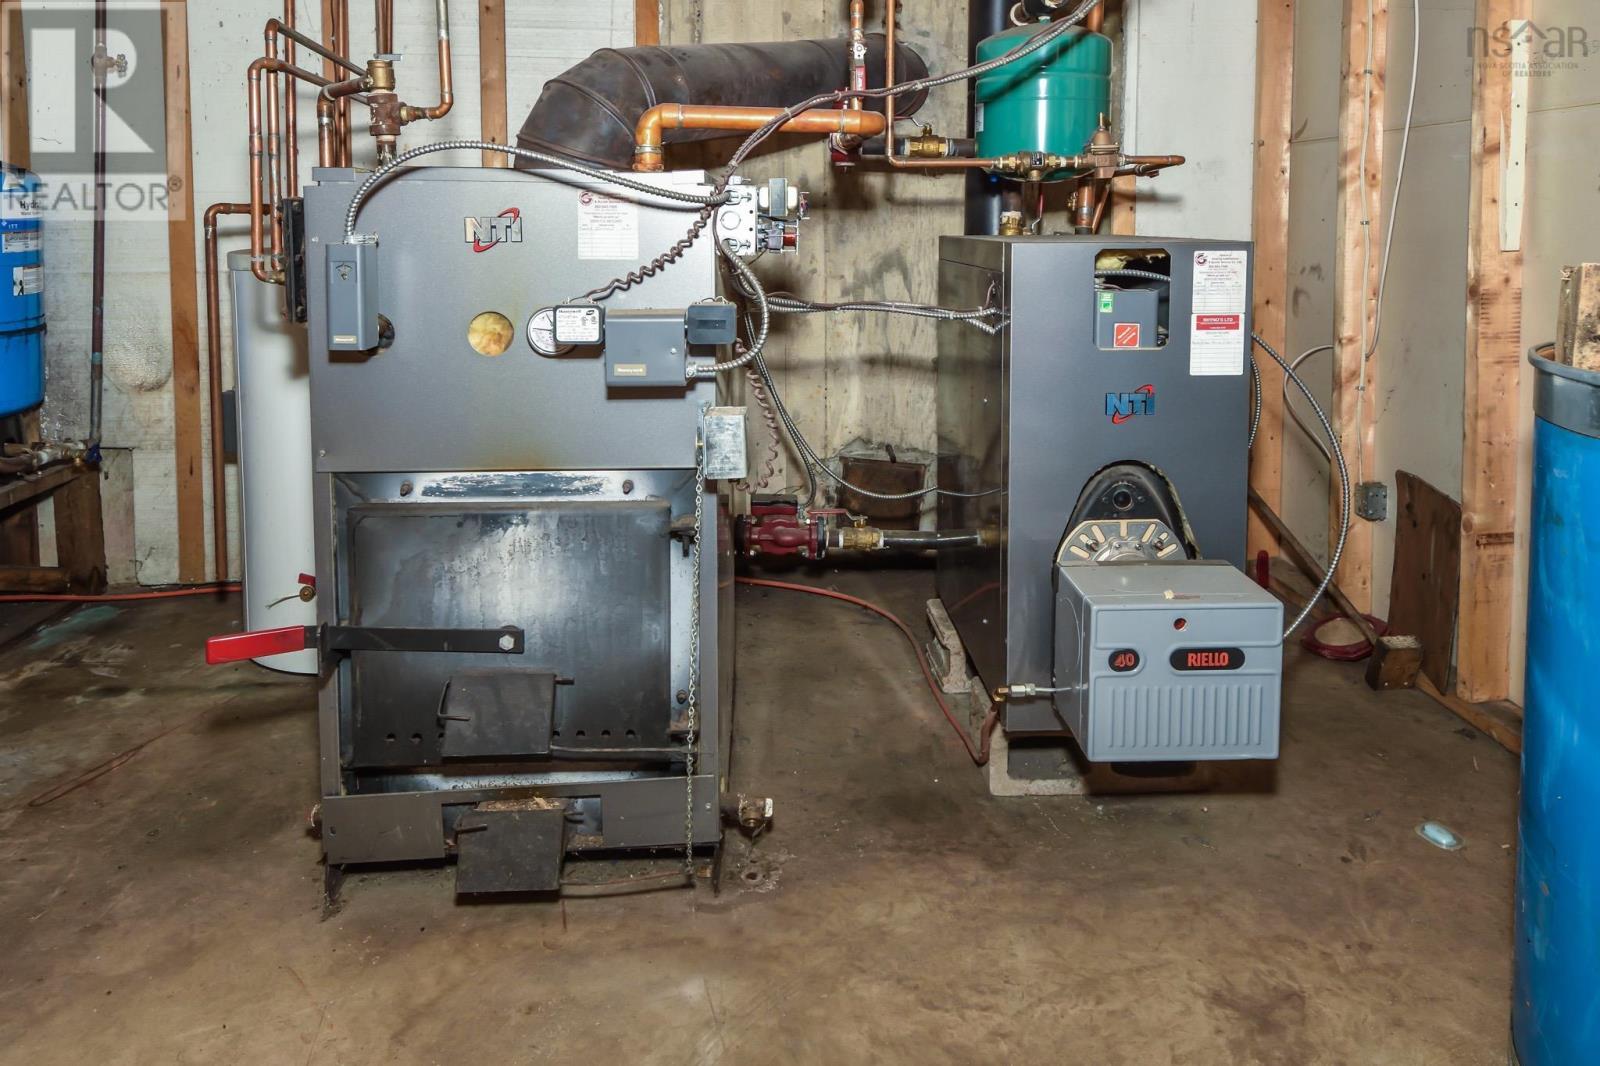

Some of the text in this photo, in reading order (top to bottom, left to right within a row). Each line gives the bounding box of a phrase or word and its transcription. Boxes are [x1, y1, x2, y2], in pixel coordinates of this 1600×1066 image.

[463, 213, 523, 246] NTI
[1105, 390, 1156, 419] NTI
[1113, 653, 1136, 668] 40
[1187, 652, 1230, 667] RIELLO
